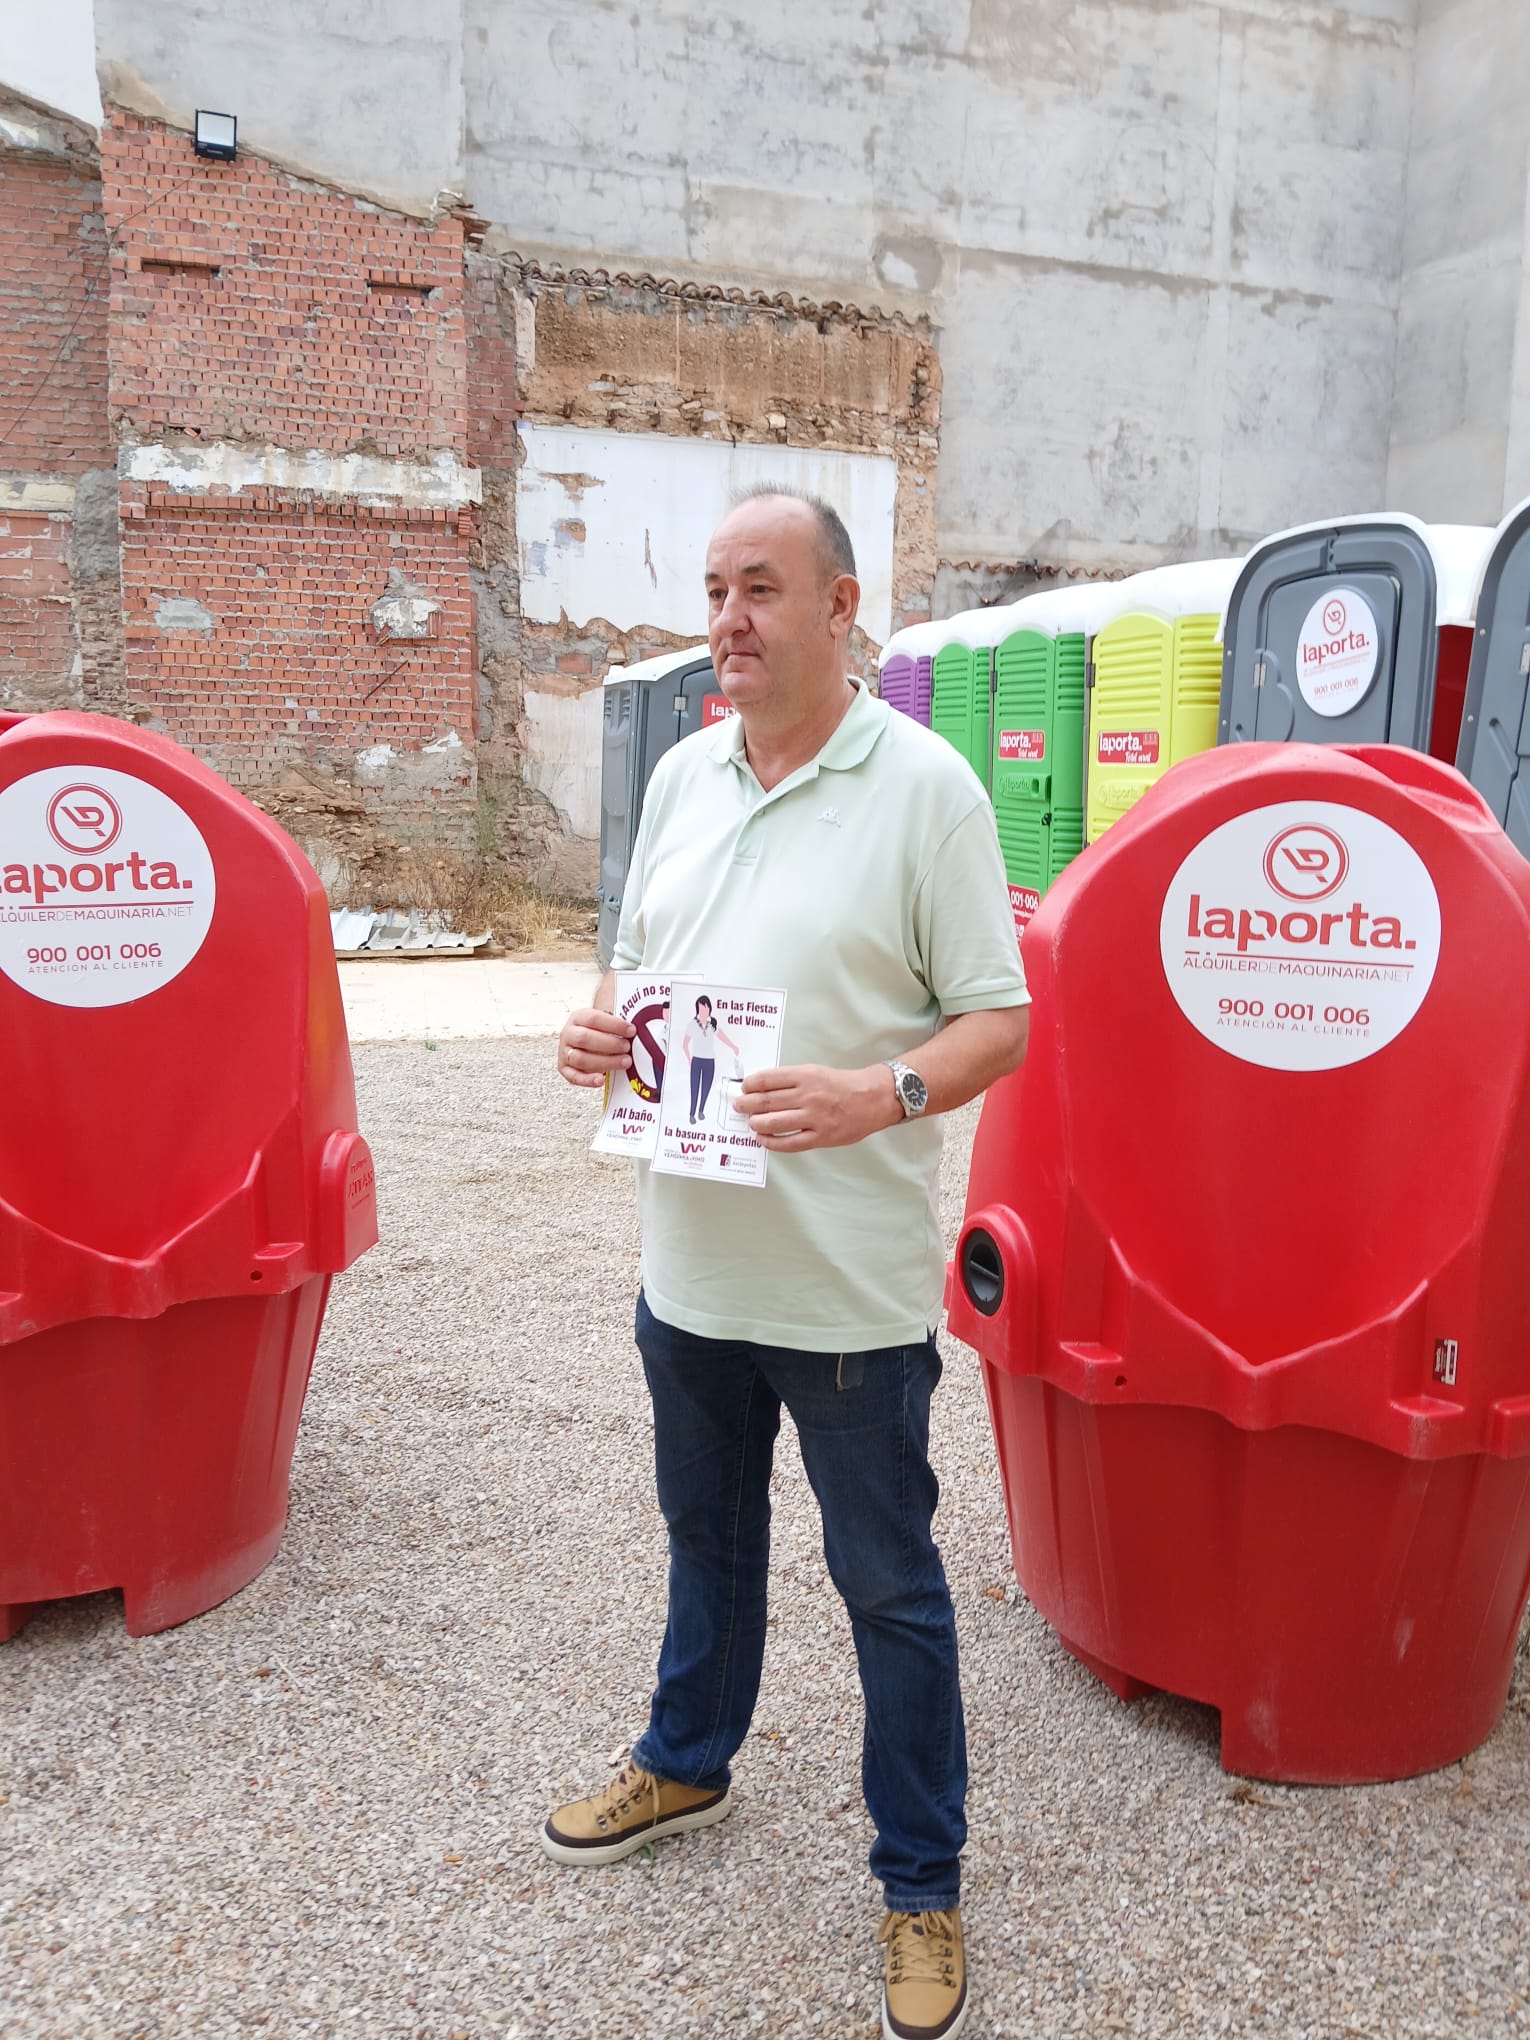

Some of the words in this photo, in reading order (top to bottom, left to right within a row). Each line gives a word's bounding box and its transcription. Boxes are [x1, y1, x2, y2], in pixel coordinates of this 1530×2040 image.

[1303, 630, 1370, 664] laporta.
[711, 702, 737, 718] lap
[1000, 730, 1032, 752] laporta.
[1099, 731, 1143, 757] laporta.
[0, 851, 193, 904] aporta.
[1025, 893, 1039, 910] 006
[1187, 894, 1417, 952] laporta.
[26, 947, 67, 964] 900
[76, 945, 111, 961] 001
[120, 943, 162, 958] 006
[93, 962, 108, 970] AL
[113, 960, 164, 970] CLIENTE
[619, 987, 642, 1021] ¡Aquí
[642, 985, 656, 998] no
[659, 985, 671, 997] se
[717, 999, 728, 1010] En
[730, 999, 744, 1011] las
[746, 1001, 778, 1014] Fiestas
[1218, 998, 1264, 1017] 900
[1274, 1001, 1314, 1022] 001
[1324, 1005, 1370, 1026] 006
[727, 1014, 743, 1025] del
[1216, 1017, 1285, 1031] ATENCIÓN
[1291, 1024, 1308, 1032] AL
[1313, 1025, 1371, 1037] CLIENTE
[612, 1107, 627, 1120] ¡Al
[628, 1108, 656, 1124] baño,
[664, 1125, 673, 1137] la
[675, 1127, 707, 1141] basura
[708, 1132, 715, 1142] a
[716, 1135, 728, 1144] su
